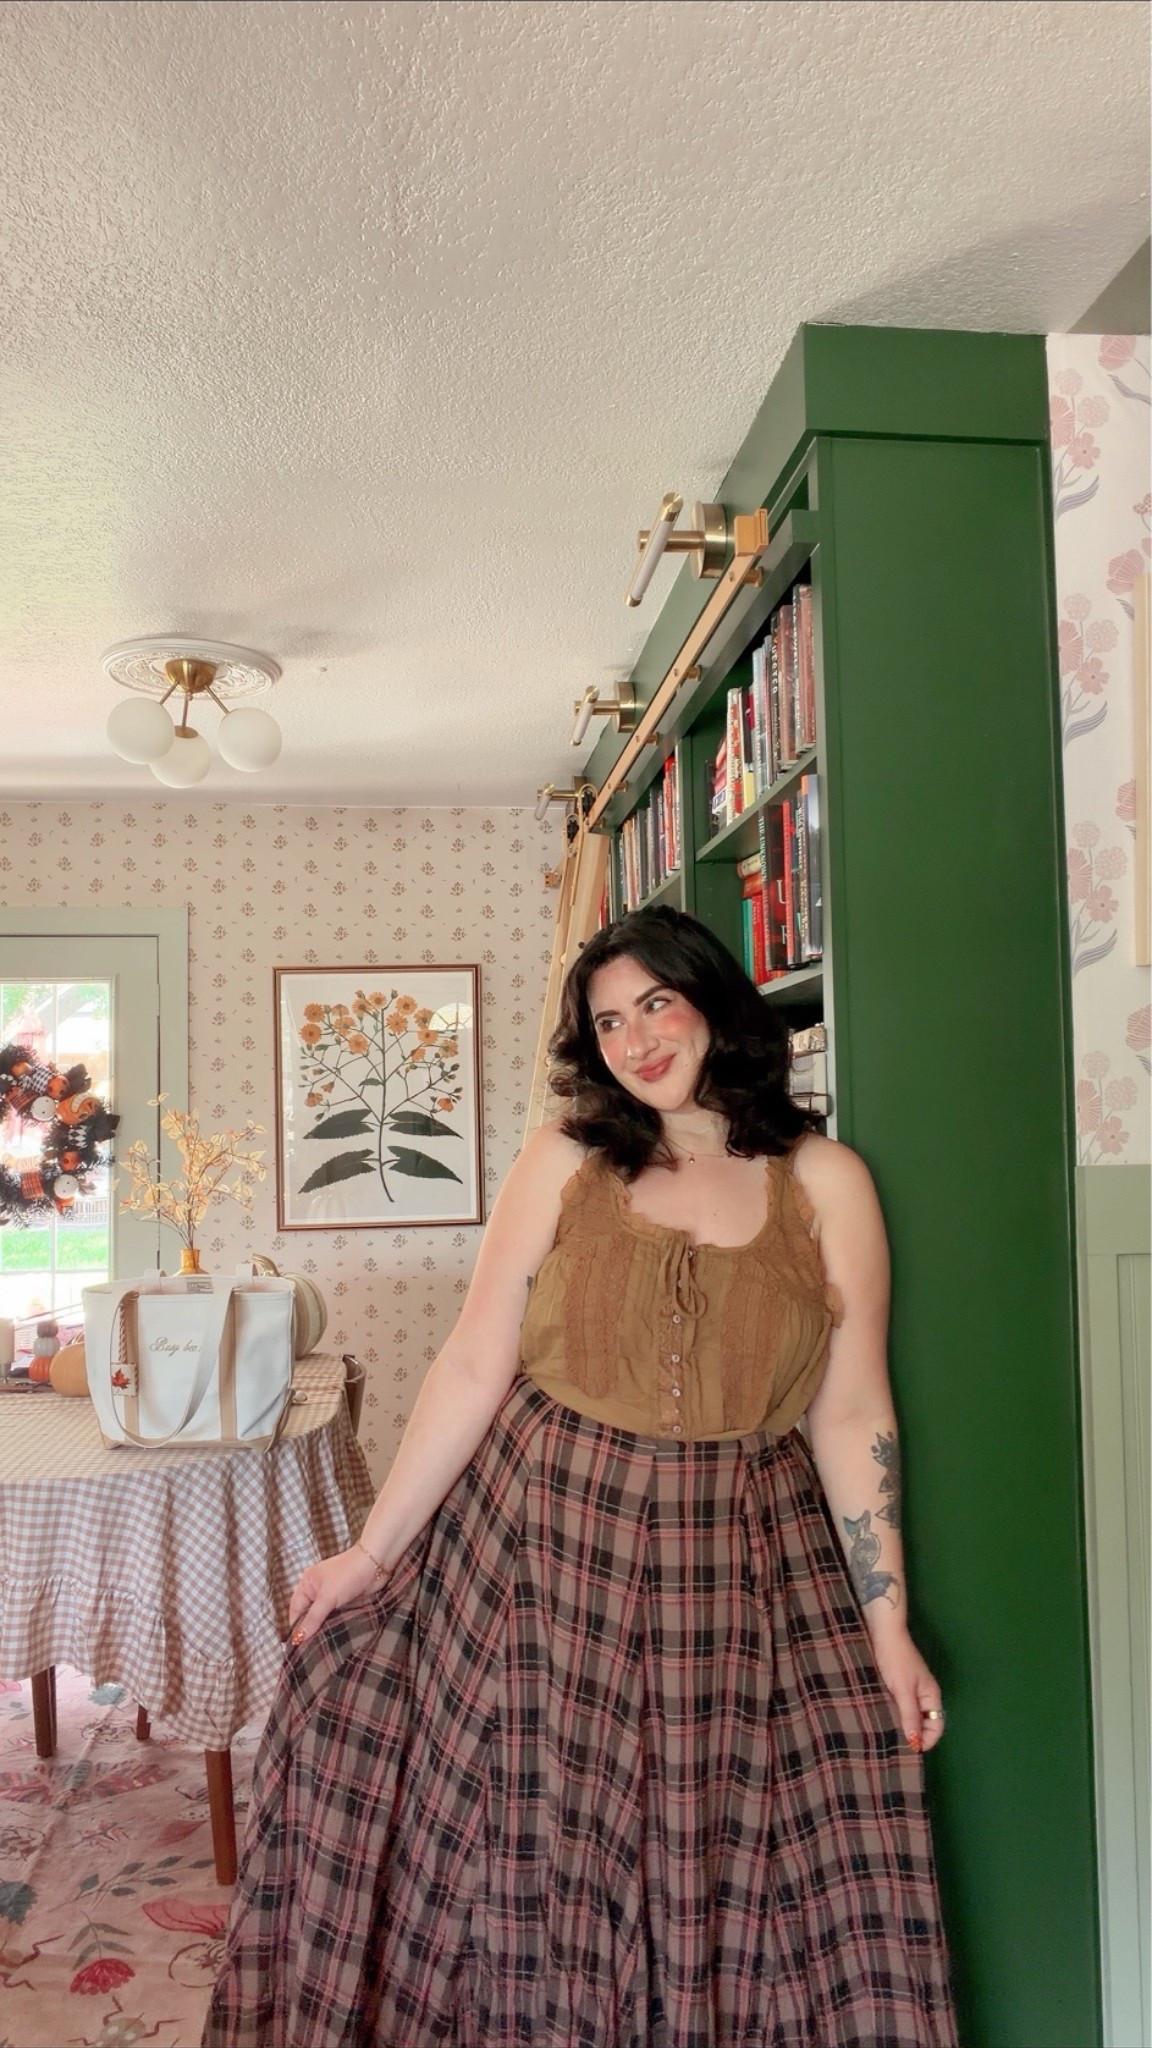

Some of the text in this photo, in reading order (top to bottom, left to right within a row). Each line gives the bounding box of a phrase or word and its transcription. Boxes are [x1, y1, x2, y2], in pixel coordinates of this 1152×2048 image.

[758, 816, 768, 882] THE UNKNOWN
[149, 1336, 180, 1357] Busy
